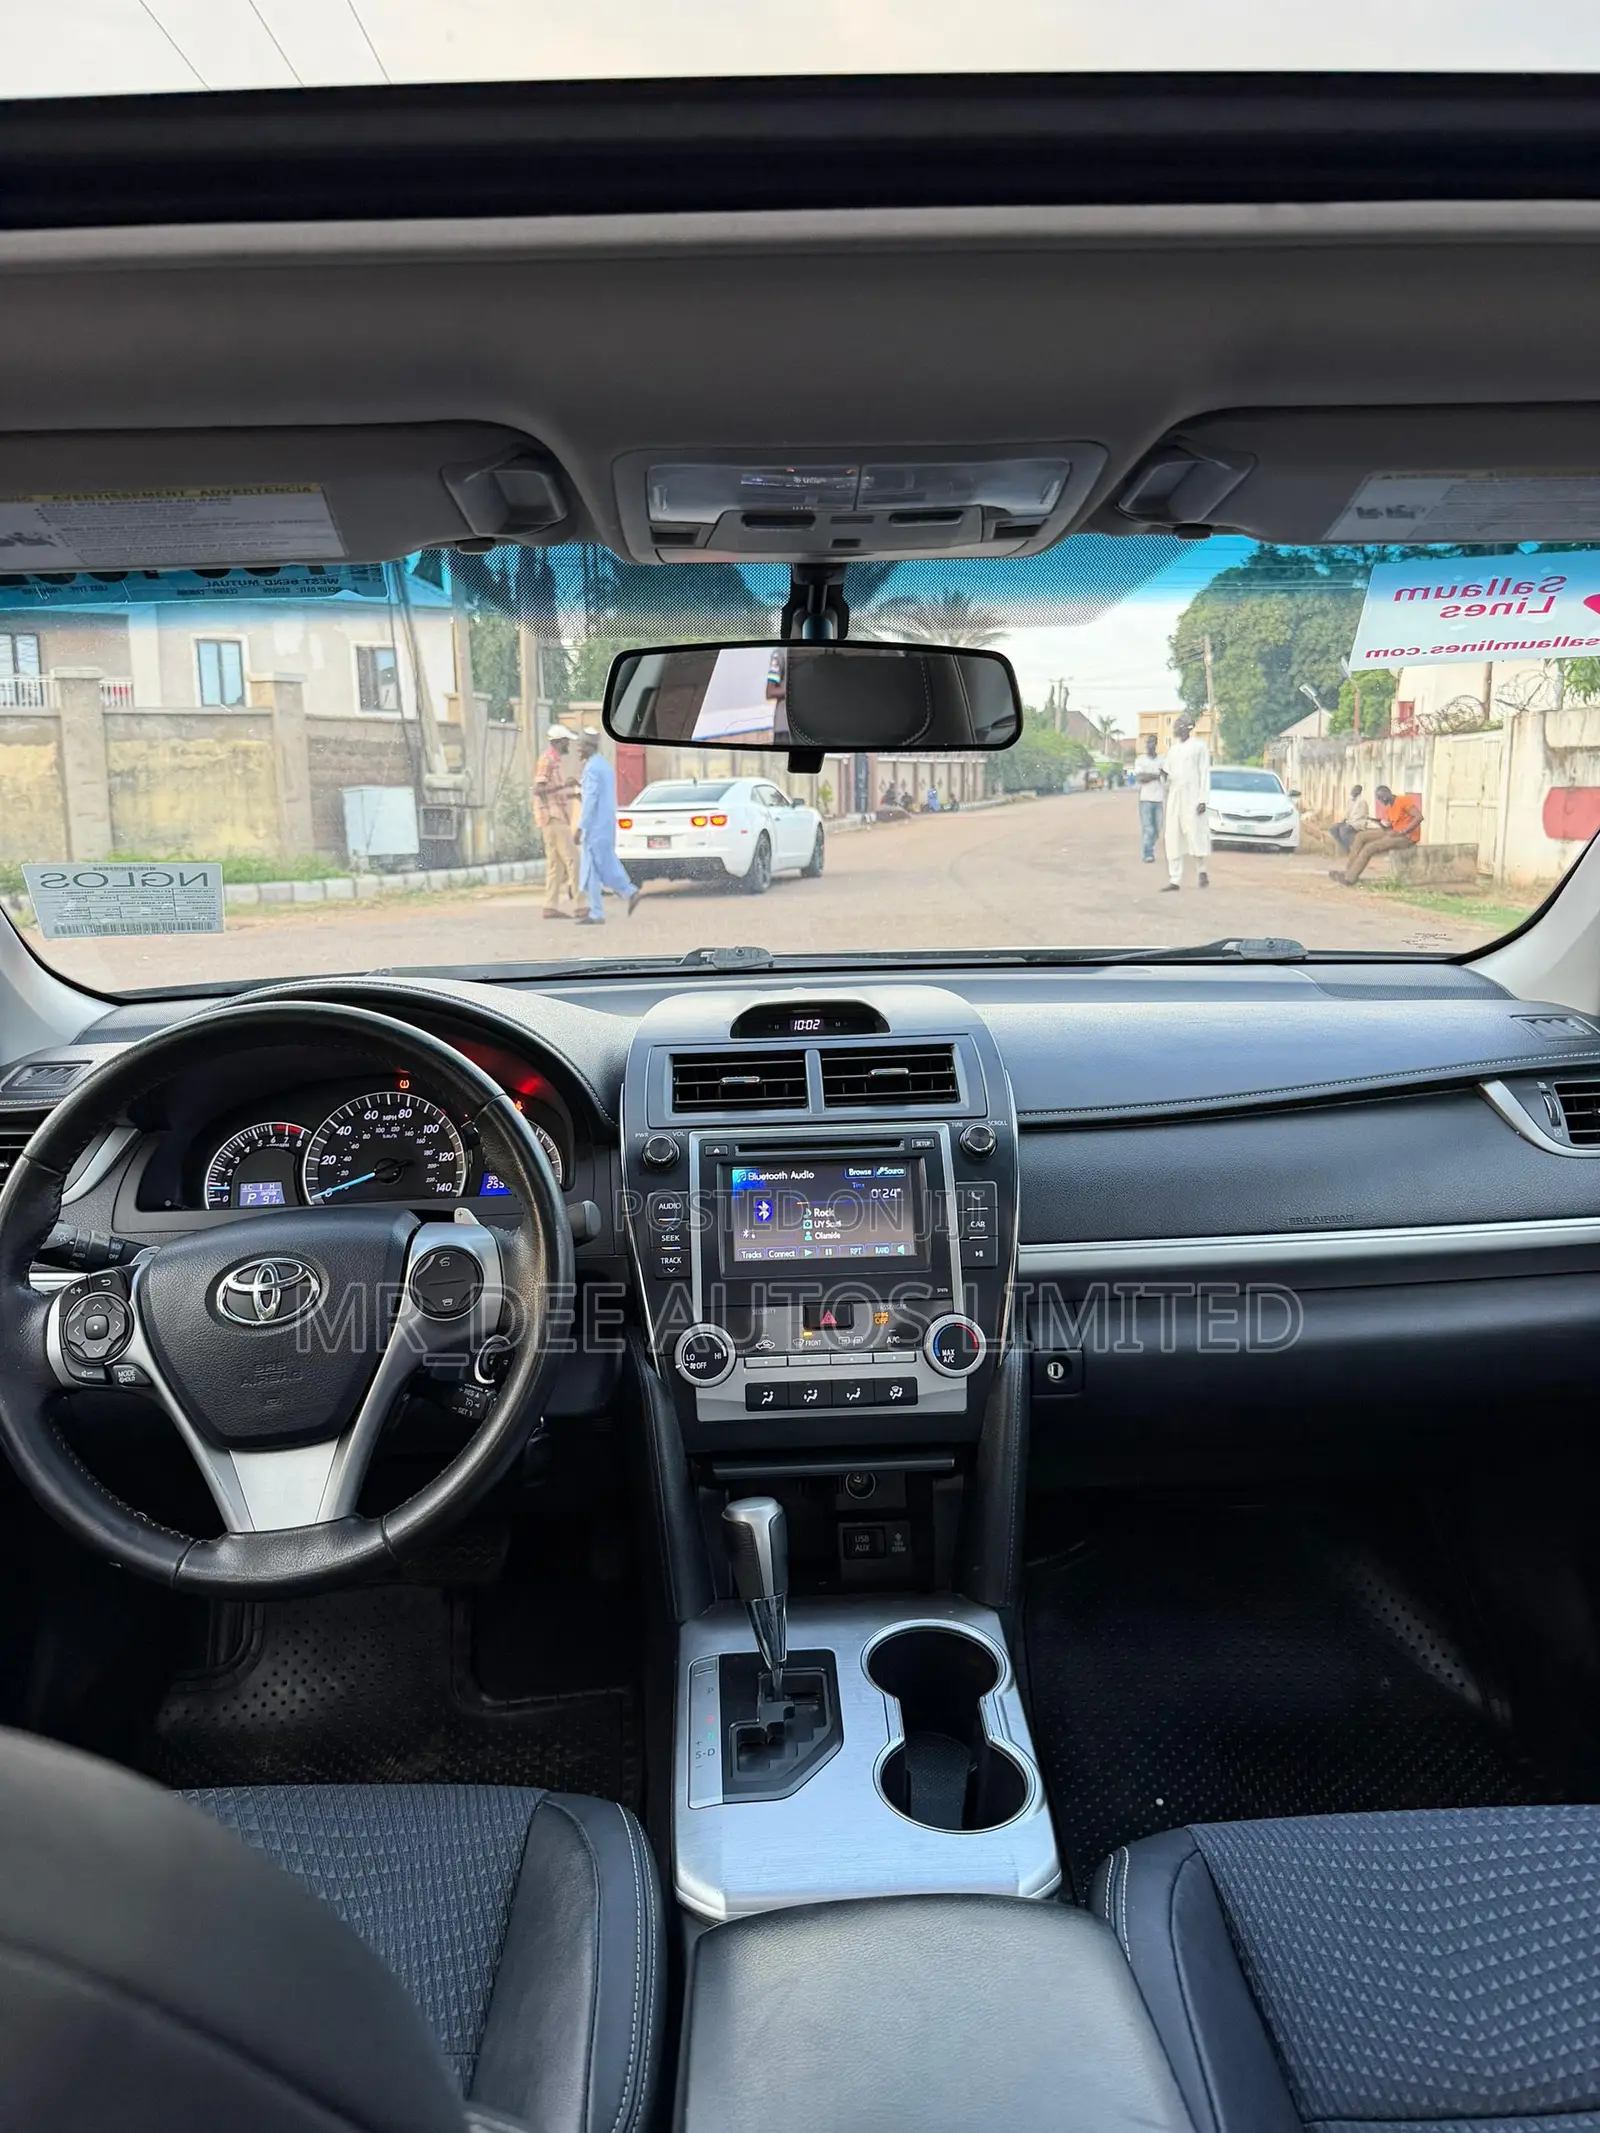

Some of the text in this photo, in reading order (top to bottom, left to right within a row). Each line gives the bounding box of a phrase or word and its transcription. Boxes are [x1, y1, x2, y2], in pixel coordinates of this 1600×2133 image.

[200, 485, 312, 497] ADVERTENCIA
[794, 1019, 820, 1031] 10:02
[364, 1110, 379, 1120] 60
[398, 1109, 412, 1119] 80
[336, 1125, 352, 1136] 40
[423, 1124, 439, 1134] 100
[320, 1155, 337, 1165] 20
[439, 1152, 454, 1162] 120
[748, 1170, 815, 1181] Bluetooth Audio
[849, 1168, 872, 1176] Browse
[883, 1167, 904, 1175] Source
[436, 1183, 452, 1192] 140
[247, 1193, 257, 1204] P
[813, 1208, 835, 1217] Rock
[814, 1219, 826, 1228] UY
[814, 1231, 841, 1240] Olamide
[741, 1250, 763, 1259] Tracks
[768, 1249, 796, 1258] Connect
[751, 1308, 777, 1316] SECURITY
[875, 1317, 889, 1325] OFF
[886, 1336, 900, 1344] A/C
[714, 1352, 722, 1360] HI
[118, 1369, 135, 1377] MODE
[855, 1535, 870, 1543] USB
[855, 1544, 870, 1552] AUX
